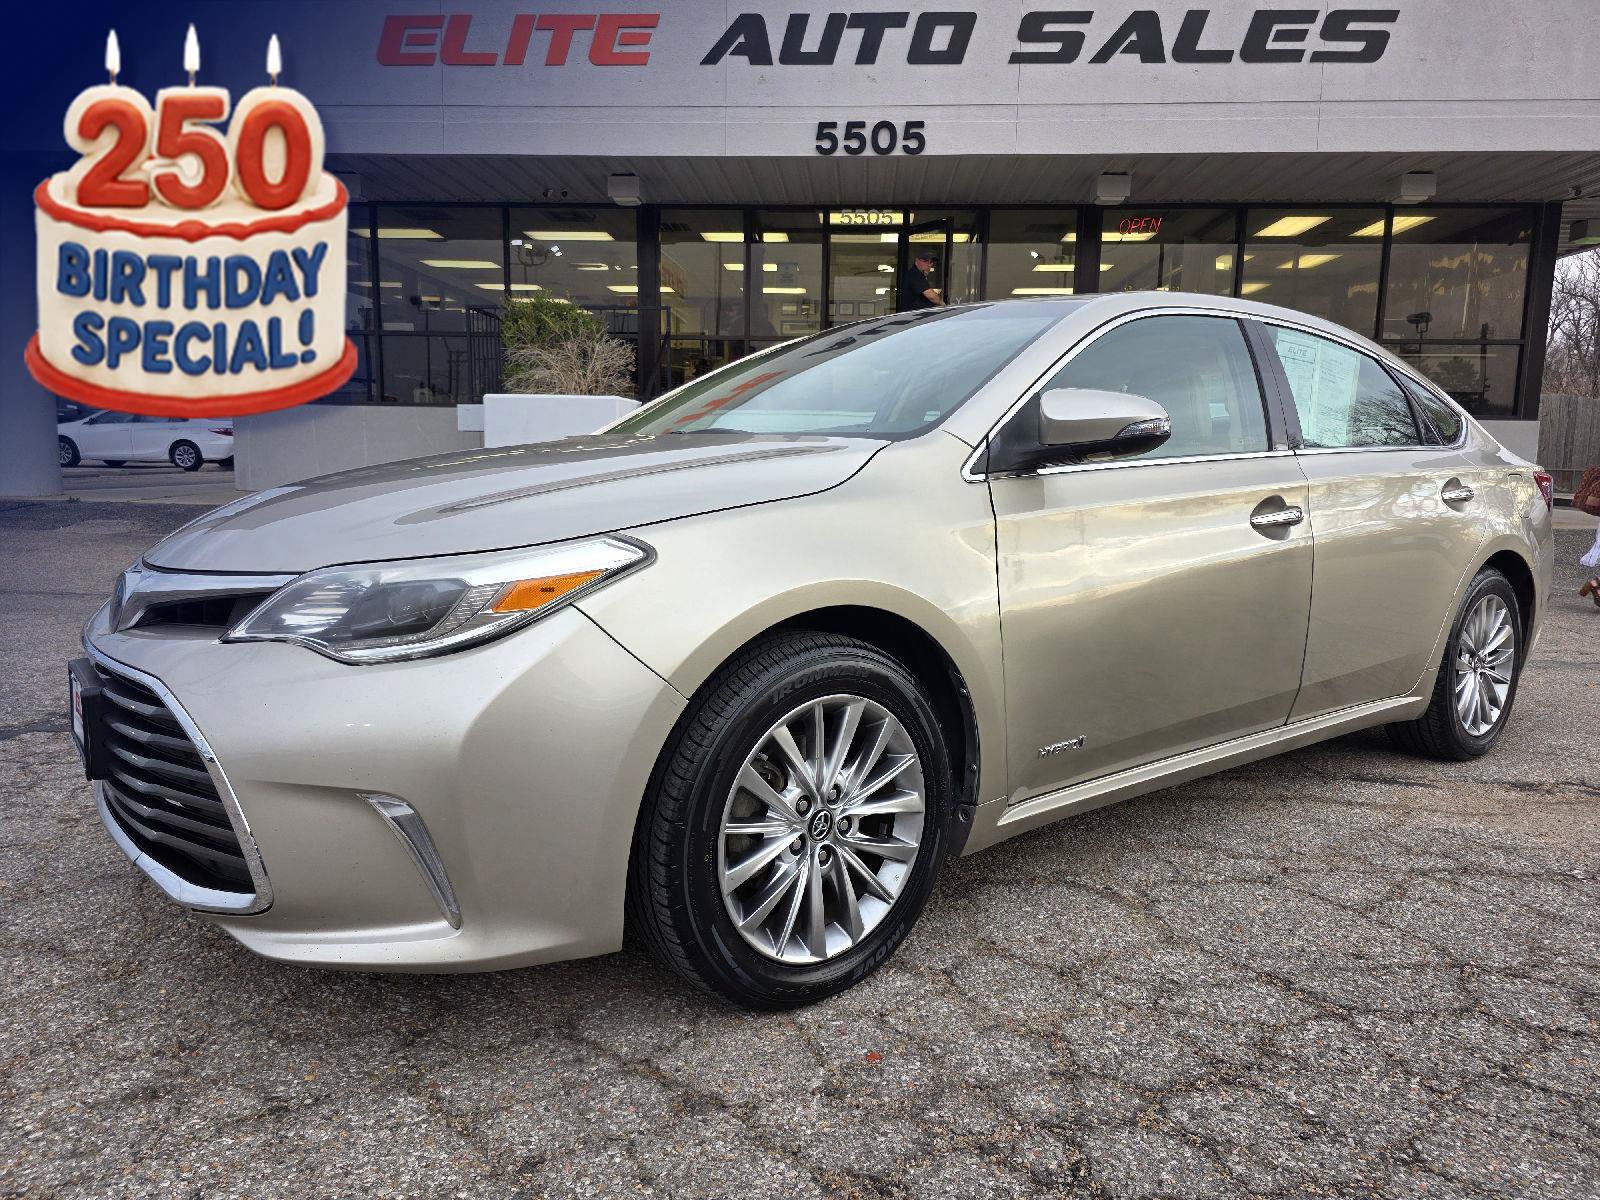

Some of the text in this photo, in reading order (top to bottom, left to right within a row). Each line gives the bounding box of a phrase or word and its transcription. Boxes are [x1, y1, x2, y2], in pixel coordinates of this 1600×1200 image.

[376, 9, 1401, 66] ELITE AUTO SALES
[815, 121, 926, 156] 5505
[840, 209, 893, 225] 5505
[1119, 217, 1163, 234] OPEN
[1287, 346, 1308, 357] ELITE
